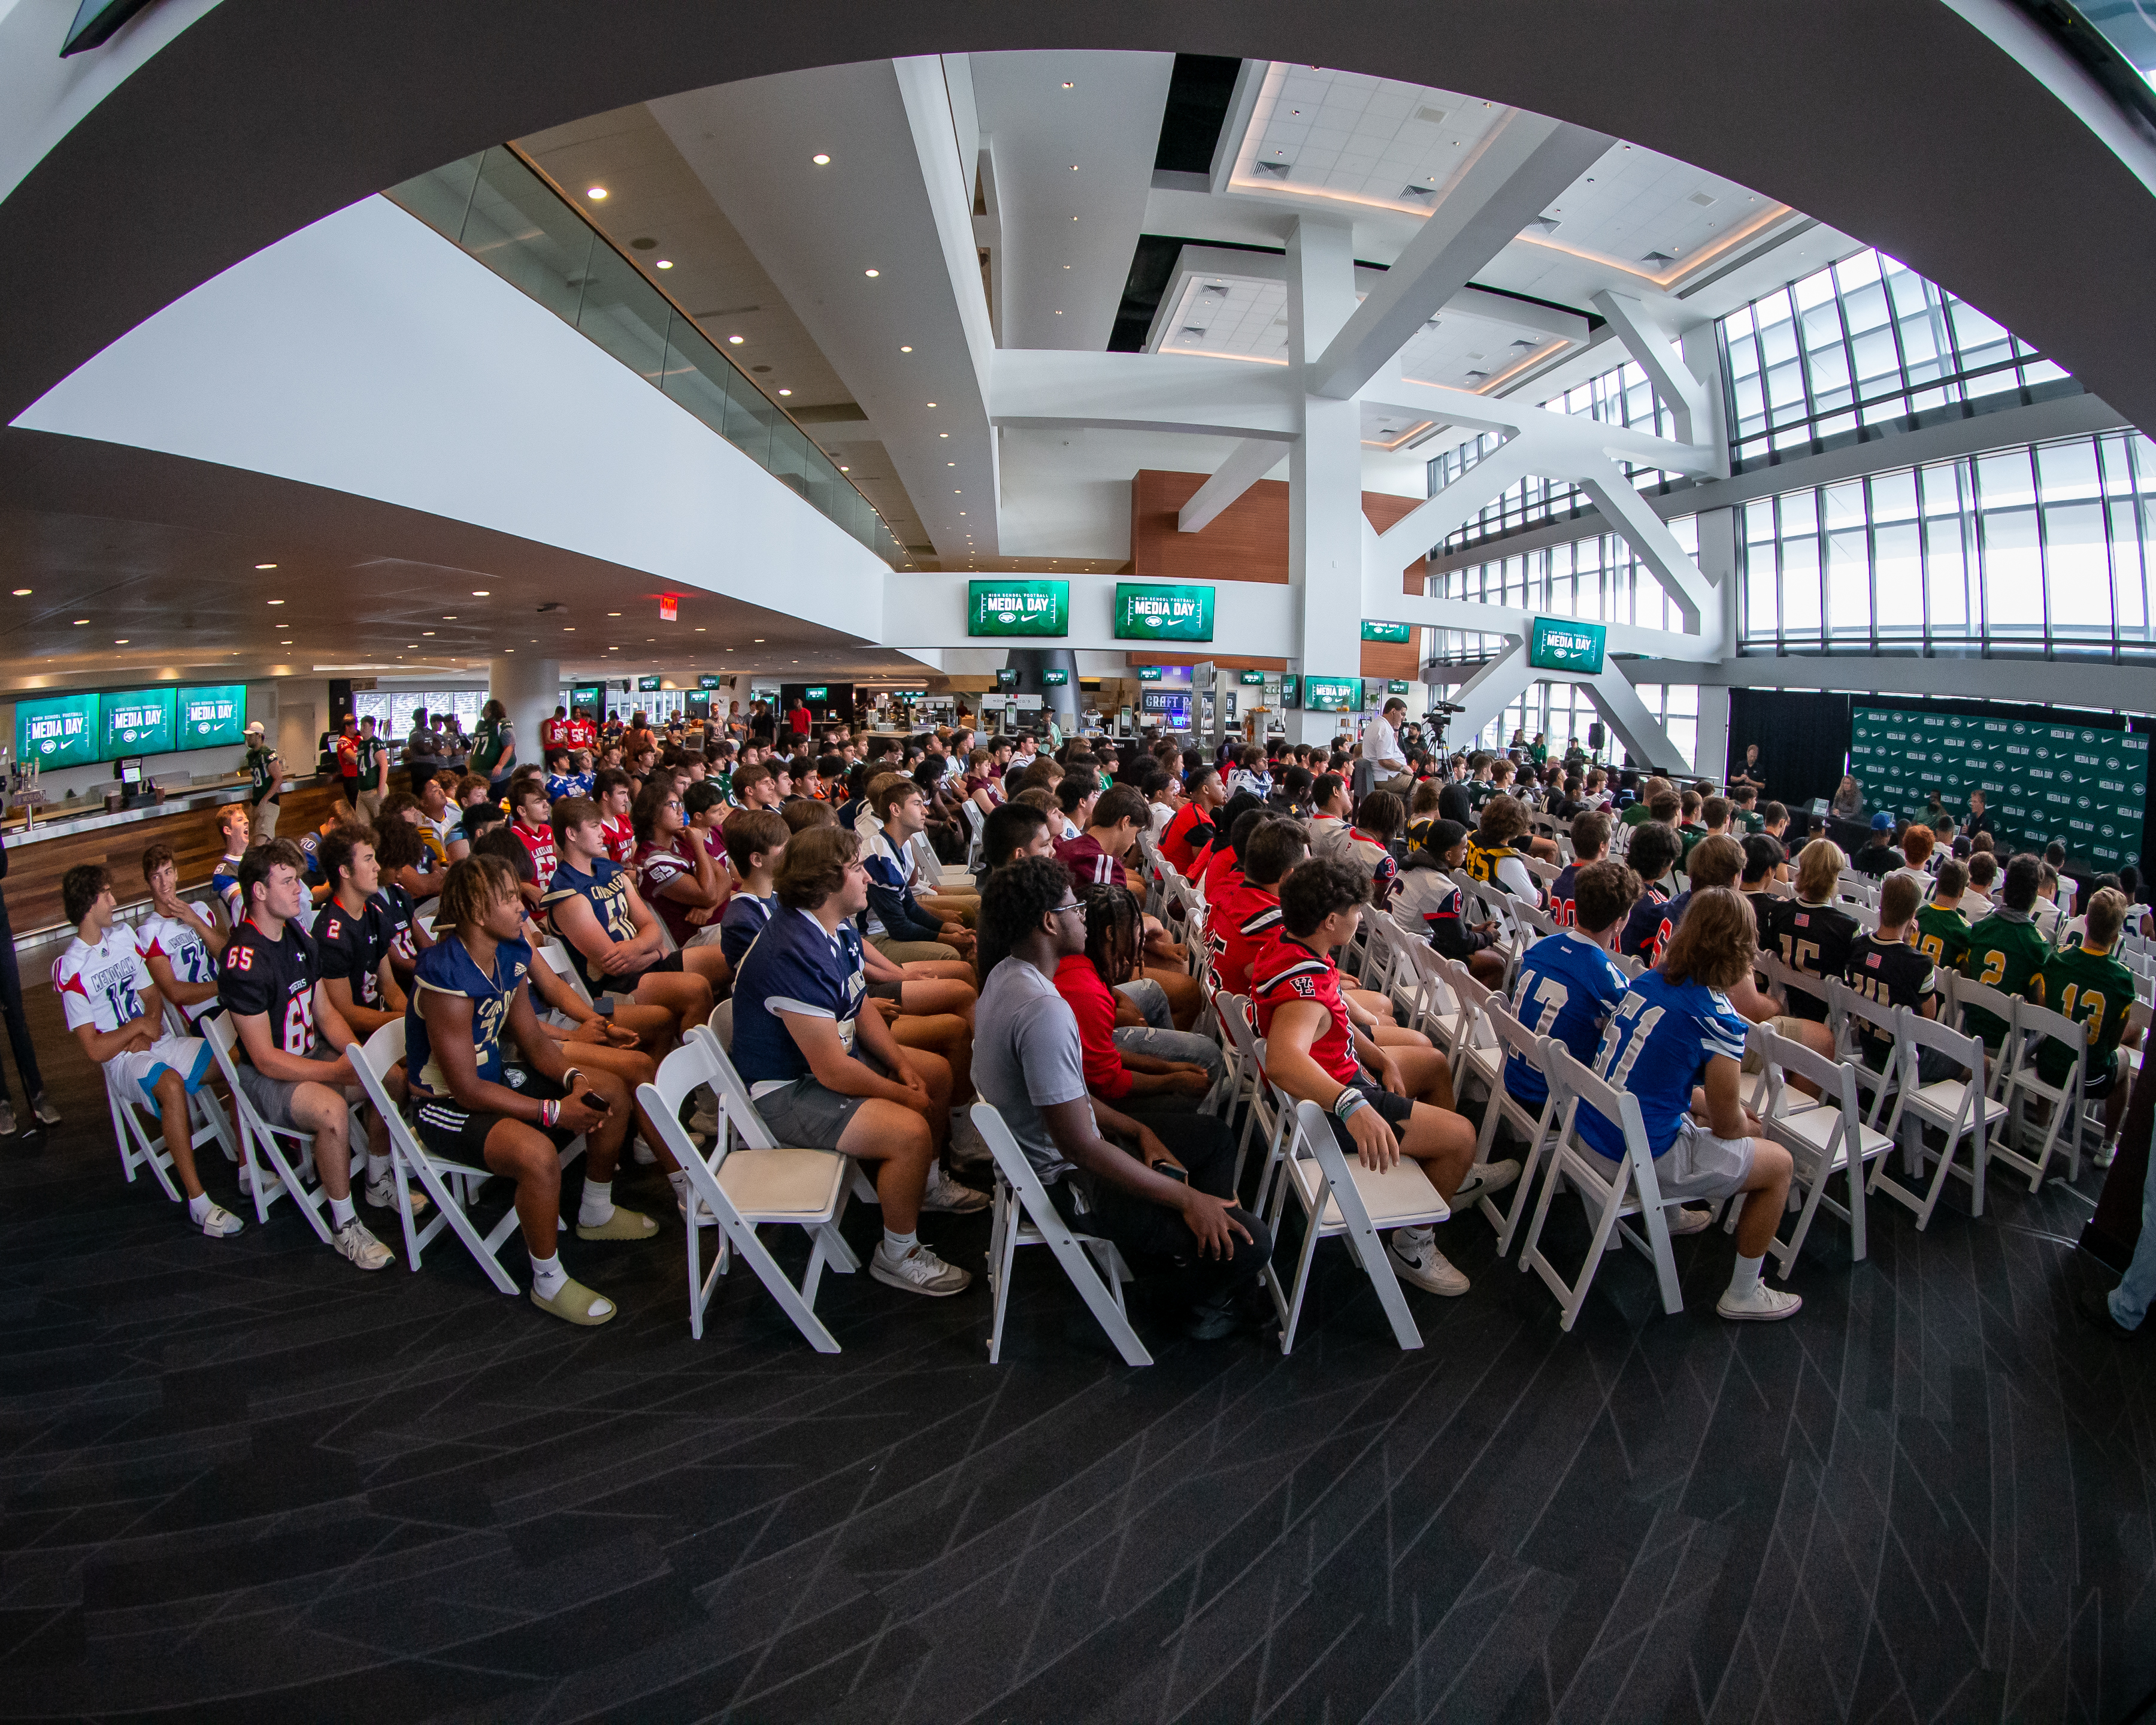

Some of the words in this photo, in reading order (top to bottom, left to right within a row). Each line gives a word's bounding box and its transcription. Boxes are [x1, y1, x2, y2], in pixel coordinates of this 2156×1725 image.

[988, 598, 1024, 611] MEDIA
[1027, 598, 1049, 611] DAY
[1135, 601, 1170, 615] MEDIA
[1174, 603, 1195, 616] DAY
[1547, 634, 1573, 648] MEDIA
[1576, 638, 1591, 650] DAY
[1316, 687, 1337, 696] MEDIA
[1146, 695, 1179, 707] CRAFT
[114, 712, 143, 728] MEDIA
[145, 710, 162, 725] DAY
[190, 706, 216, 721] MEDIA
[217, 704, 232, 719] DAY
[31, 720, 62, 739] MEDIA
[65, 718, 83, 735] DAY
[473, 736, 489, 755] 77
[2122, 739, 2137, 749] MEDIA
[2139, 742, 2148, 750] DAY
[2075, 755, 2089, 764] MEDIA
[2090, 756, 2099, 765] DAY
[2030, 768, 2043, 777] MEDIA
[2045, 770, 2053, 779] DAY
[1995, 783, 2003, 792] DAY
[2099, 780, 2113, 790] MEDIA
[2115, 782, 2124, 792] DAY
[2047, 793, 2060, 802] MEDIA
[2062, 795, 2071, 804] DAY
[2003, 806, 2015, 815] MEDIA
[2017, 807, 2025, 816] DAY
[2117, 807, 2131, 817] MEDIA
[2133, 809, 2143, 819] DAY
[2070, 819, 2084, 829] MEDIA
[2085, 822, 2094, 831] DAY
[2025, 830, 2038, 840] MEDIA
[2039, 833, 2048, 842] DAY
[2093, 846, 2107, 857] MEDIA
[2109, 849, 2118, 860] DAY
[1385, 857, 1395, 878] 3
[327, 918, 341, 939] 2
[226, 946, 254, 971] 65
[1979, 949, 2006, 985] 2
[91, 957, 135, 992] MENDHAM
[1509, 969, 1575, 1073] 17
[2061, 983, 2106, 1045] 13
[1591, 990, 1666, 1092] 51
[381, 1190, 393, 1200] N
